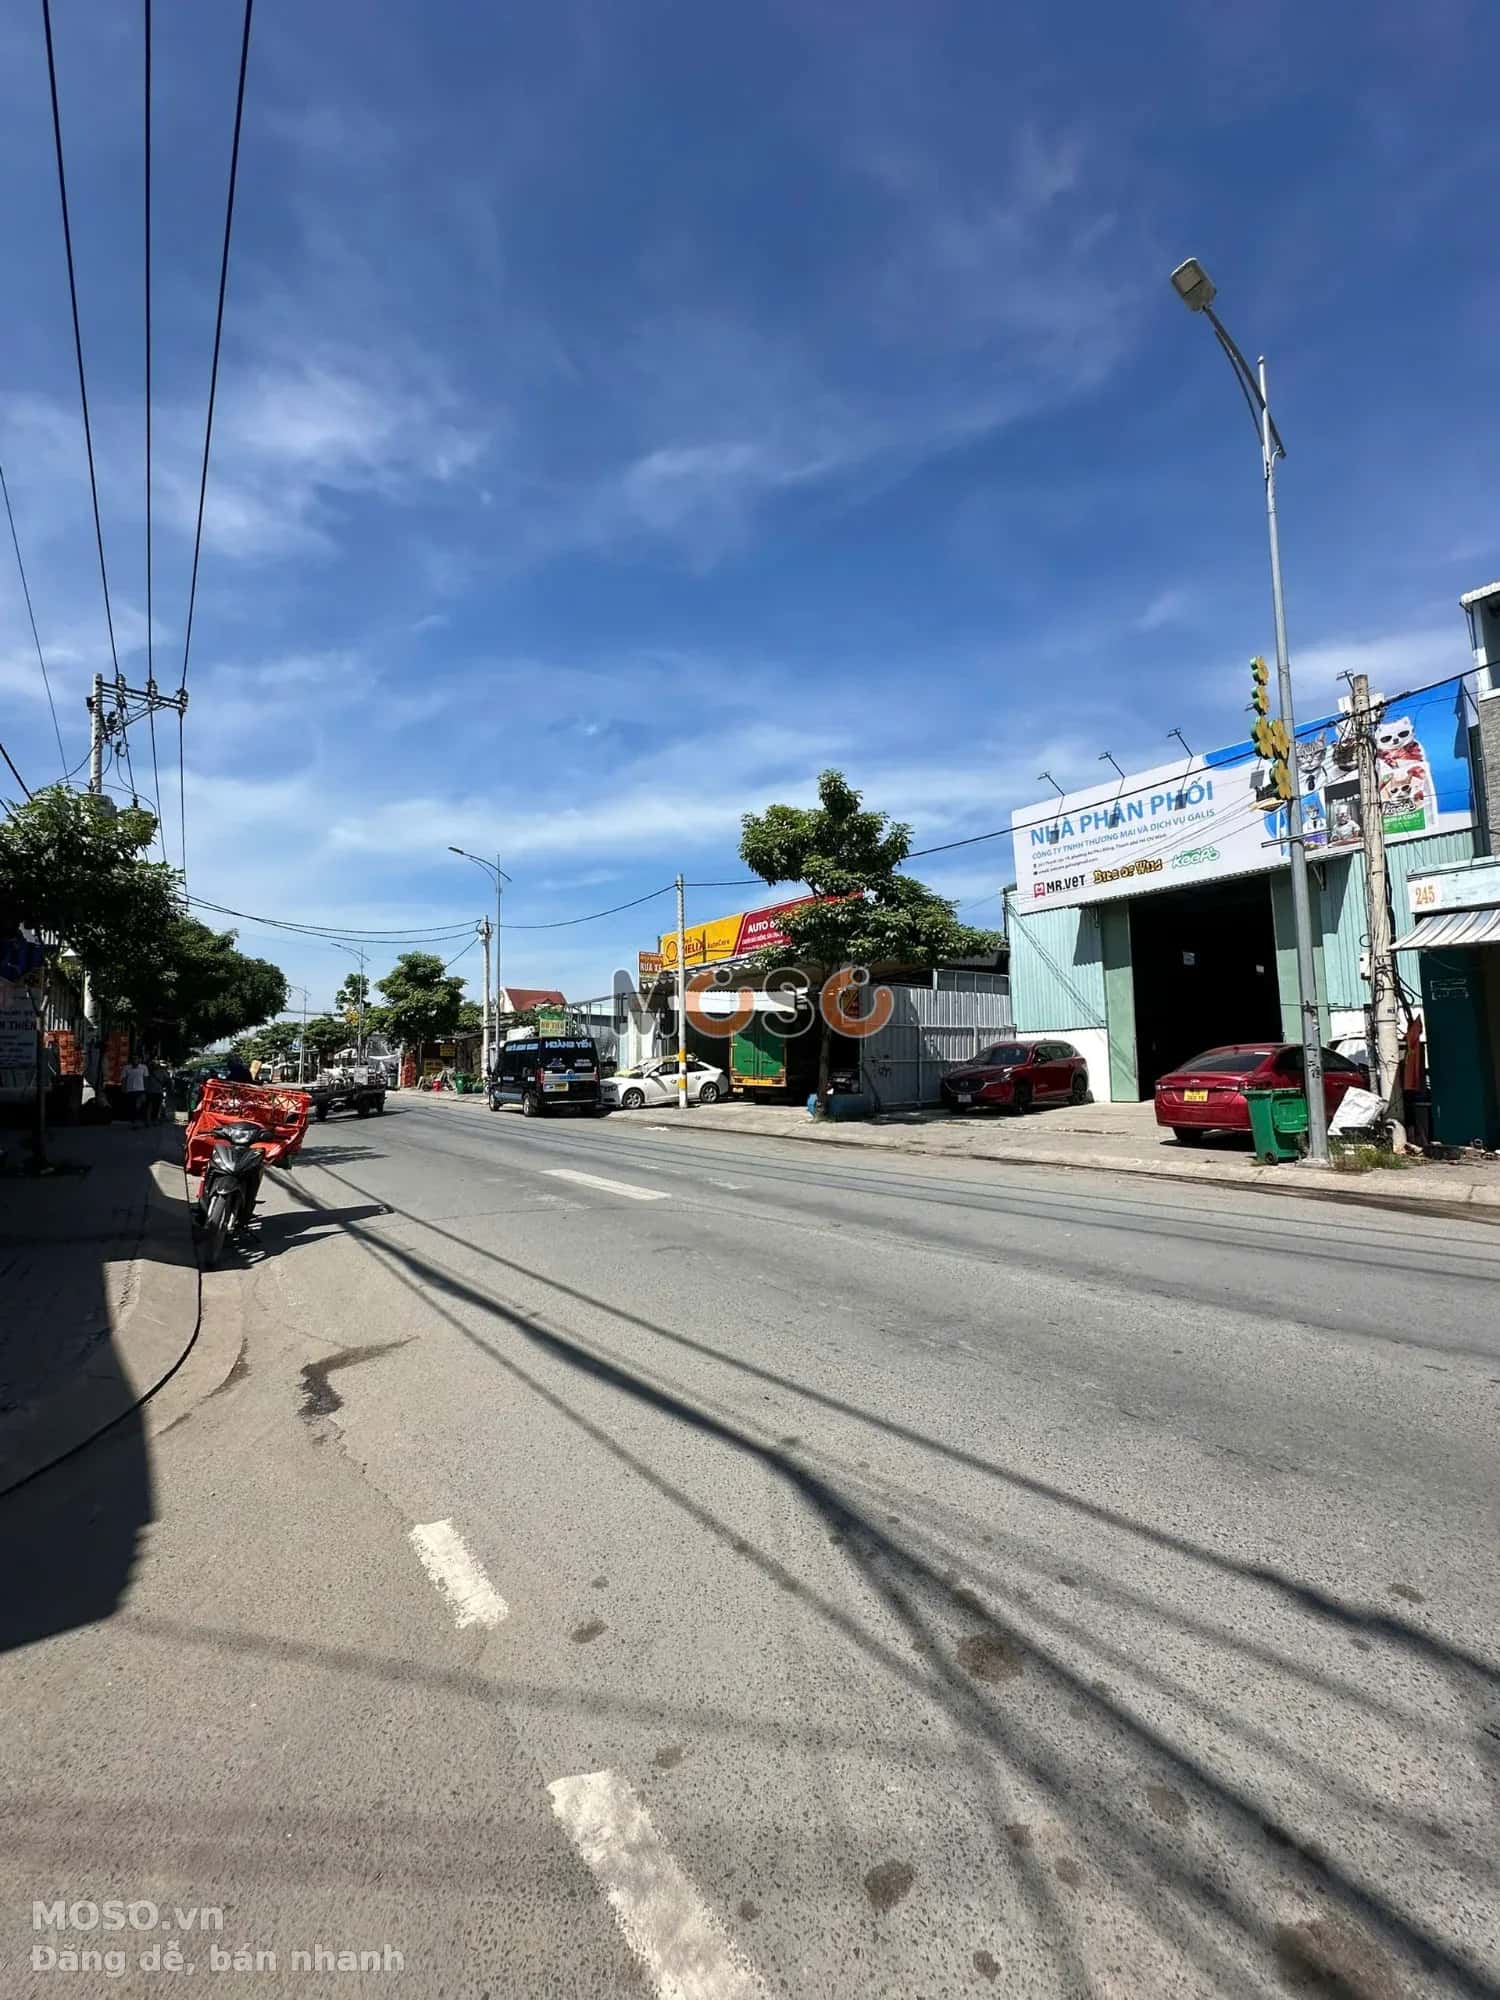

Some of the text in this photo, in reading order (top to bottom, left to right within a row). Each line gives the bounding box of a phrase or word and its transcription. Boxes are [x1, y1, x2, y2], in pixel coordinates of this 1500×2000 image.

[1030, 777, 1214, 846] NHÀ PHÂN PHỐI
[1053, 846, 1063, 856] TY
[1063, 842, 1082, 854] TNHH
[1415, 884, 1436, 905] 245
[748, 920, 769, 934] AUTO
